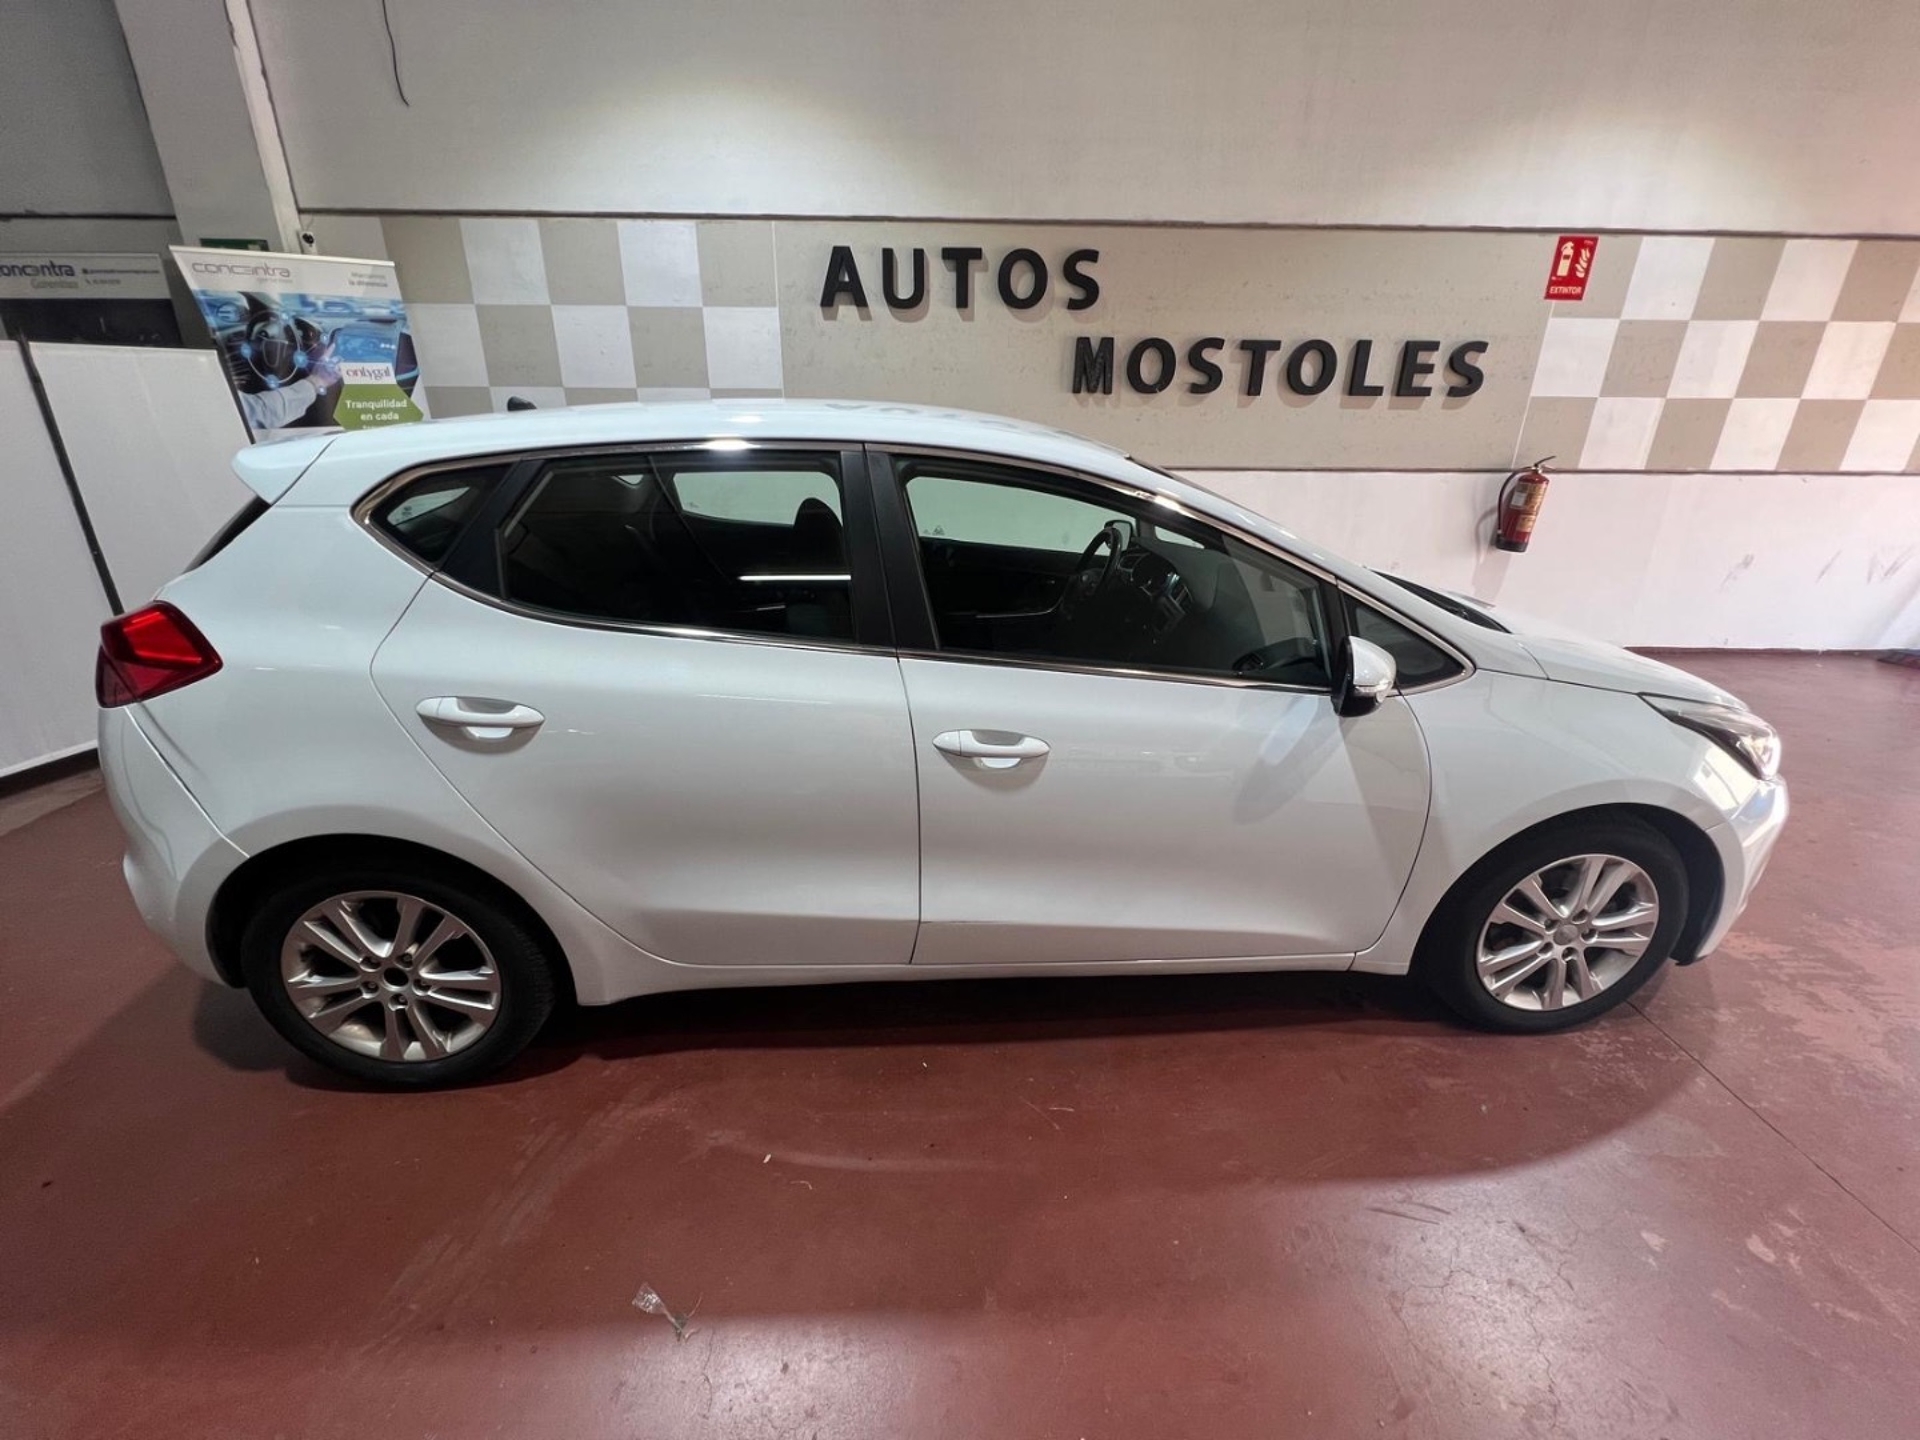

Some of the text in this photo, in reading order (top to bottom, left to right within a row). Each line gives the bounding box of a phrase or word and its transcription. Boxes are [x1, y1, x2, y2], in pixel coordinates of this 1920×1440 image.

[820, 245, 1101, 311] AUTOS
[1071, 336, 1489, 398] MOSTOLES
[345, 399, 408, 411] Tranquilidad
[375, 412, 399, 420] cada
